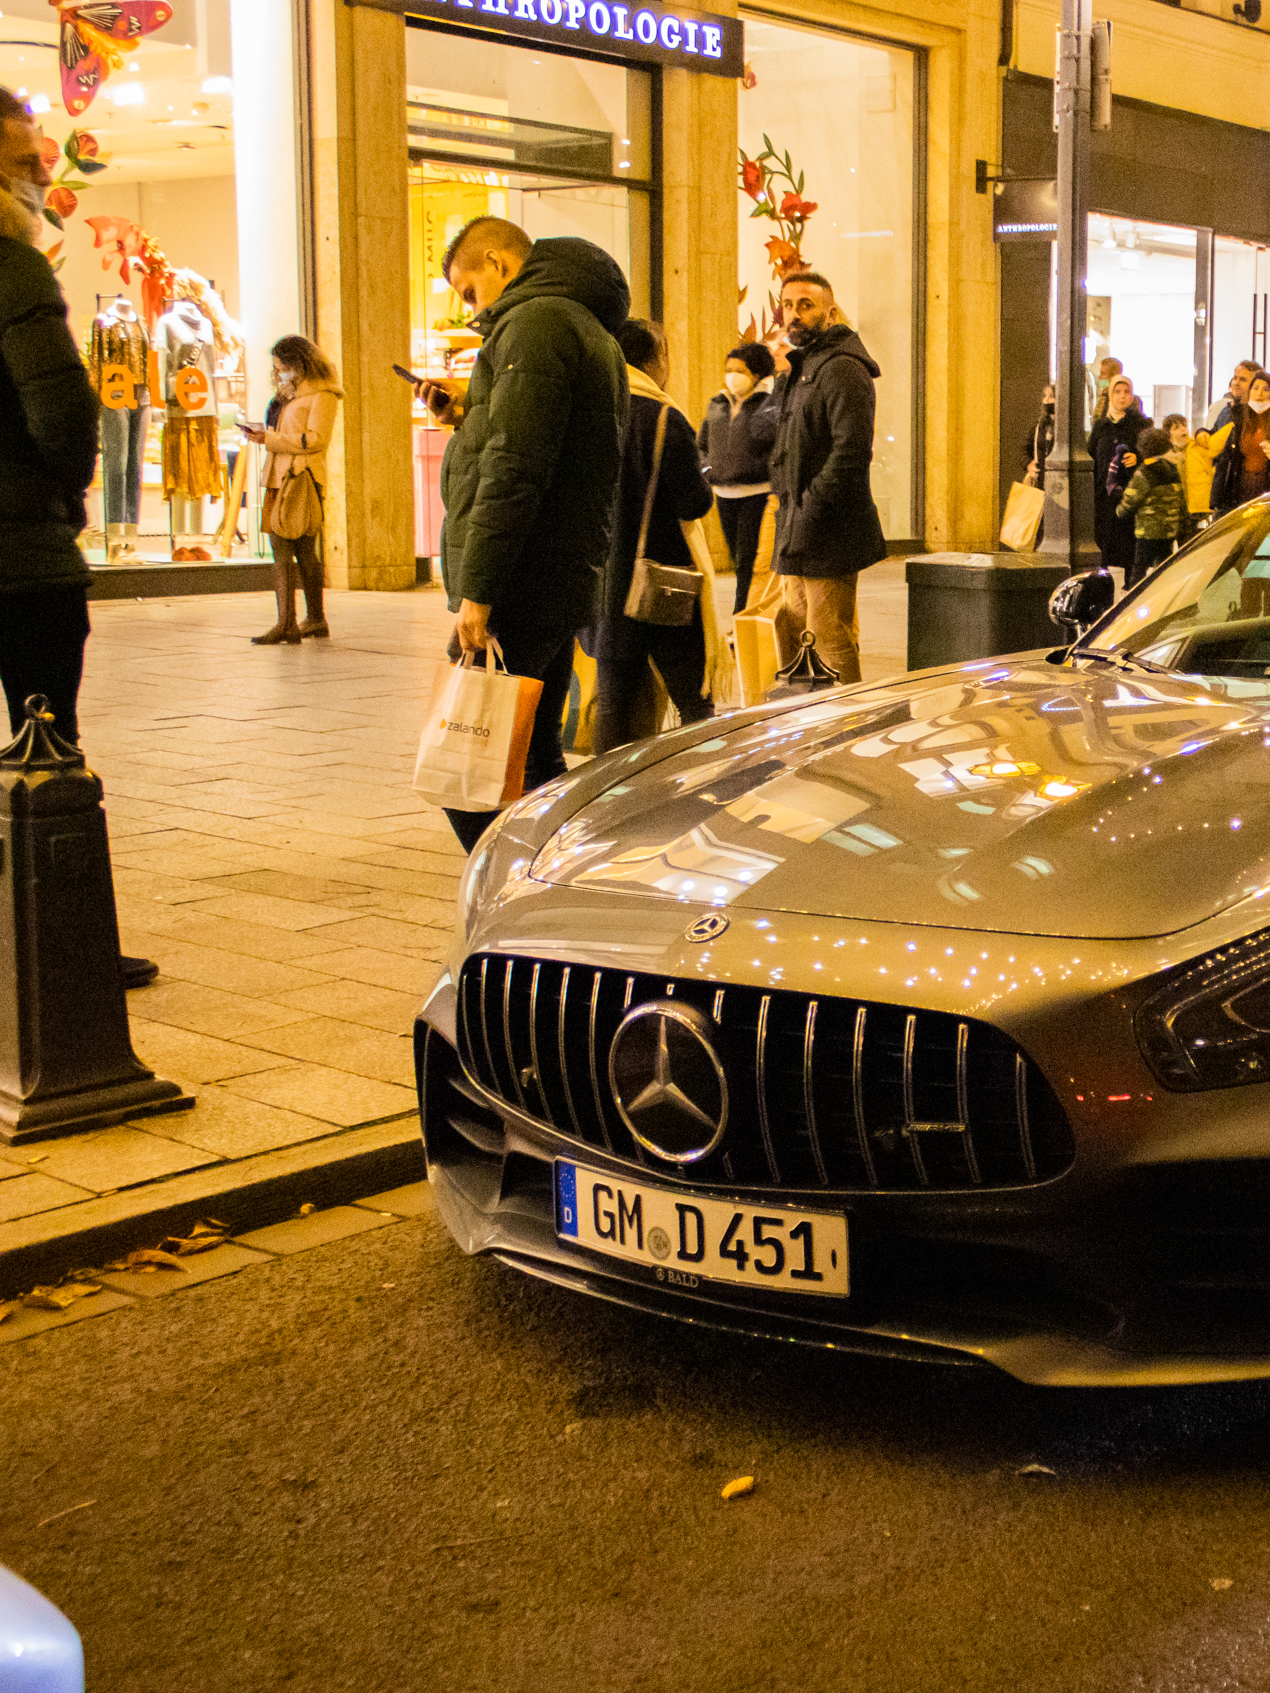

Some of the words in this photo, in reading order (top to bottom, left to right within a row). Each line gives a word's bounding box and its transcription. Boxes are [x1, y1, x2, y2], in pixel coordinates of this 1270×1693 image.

[100, 349, 209, 411] ale
[447, 721, 490, 738] zalando
[563, 1206, 573, 1223] D
[592, 1182, 644, 1250] GM
[675, 1202, 705, 1263] D
[719, 1212, 824, 1282] 451
[667, 1272, 699, 1288] BALD
